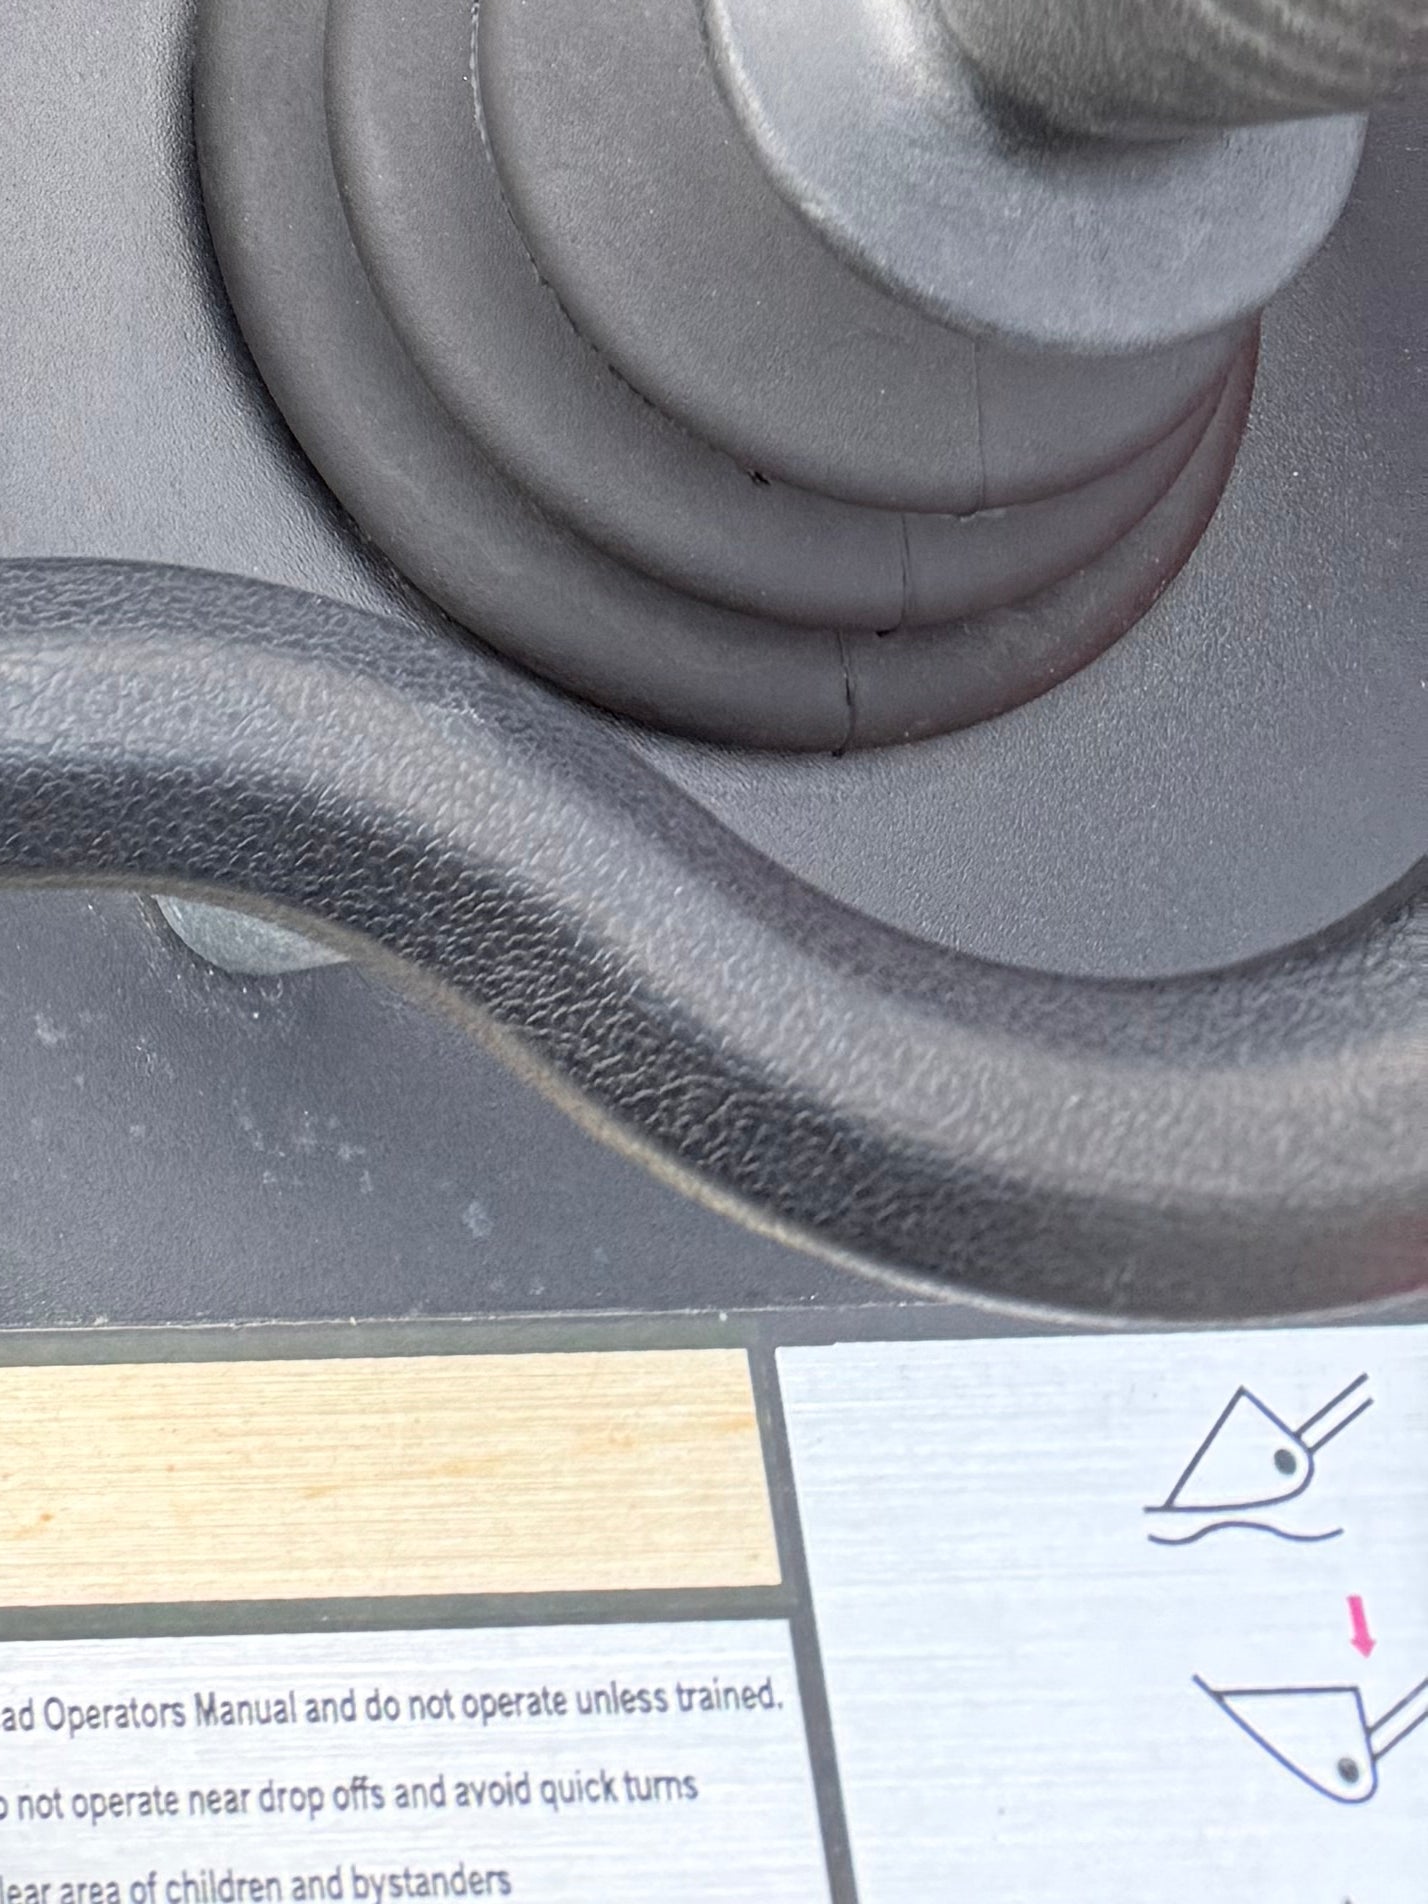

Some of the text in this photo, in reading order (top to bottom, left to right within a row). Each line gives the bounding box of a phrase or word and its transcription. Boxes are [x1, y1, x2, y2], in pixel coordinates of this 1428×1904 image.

[43, 1695, 186, 1738] Operators
[194, 1690, 297, 1727] Manual
[304, 1688, 356, 1724] and
[365, 1688, 401, 1720] do
[408, 1688, 453, 1721] not
[461, 1686, 568, 1726] operate
[576, 1680, 669, 1715] unless
[676, 1676, 785, 1713] trained.
[17, 1787, 65, 1820] not
[72, 1786, 180, 1826] operate
[188, 1786, 251, 1817] near
[258, 1779, 325, 1821] drop
[332, 1775, 386, 1811] offs
[394, 1774, 446, 1808] and
[455, 1772, 530, 1807] avoid
[539, 1770, 617, 1812] quick
[623, 1772, 700, 1803] turns
[59, 1880, 120, 1904] area
[129, 1870, 158, 1904] of
[165, 1867, 289, 1904] children
[291, 1865, 344, 1902] and
[350, 1862, 513, 1904] bystanders
